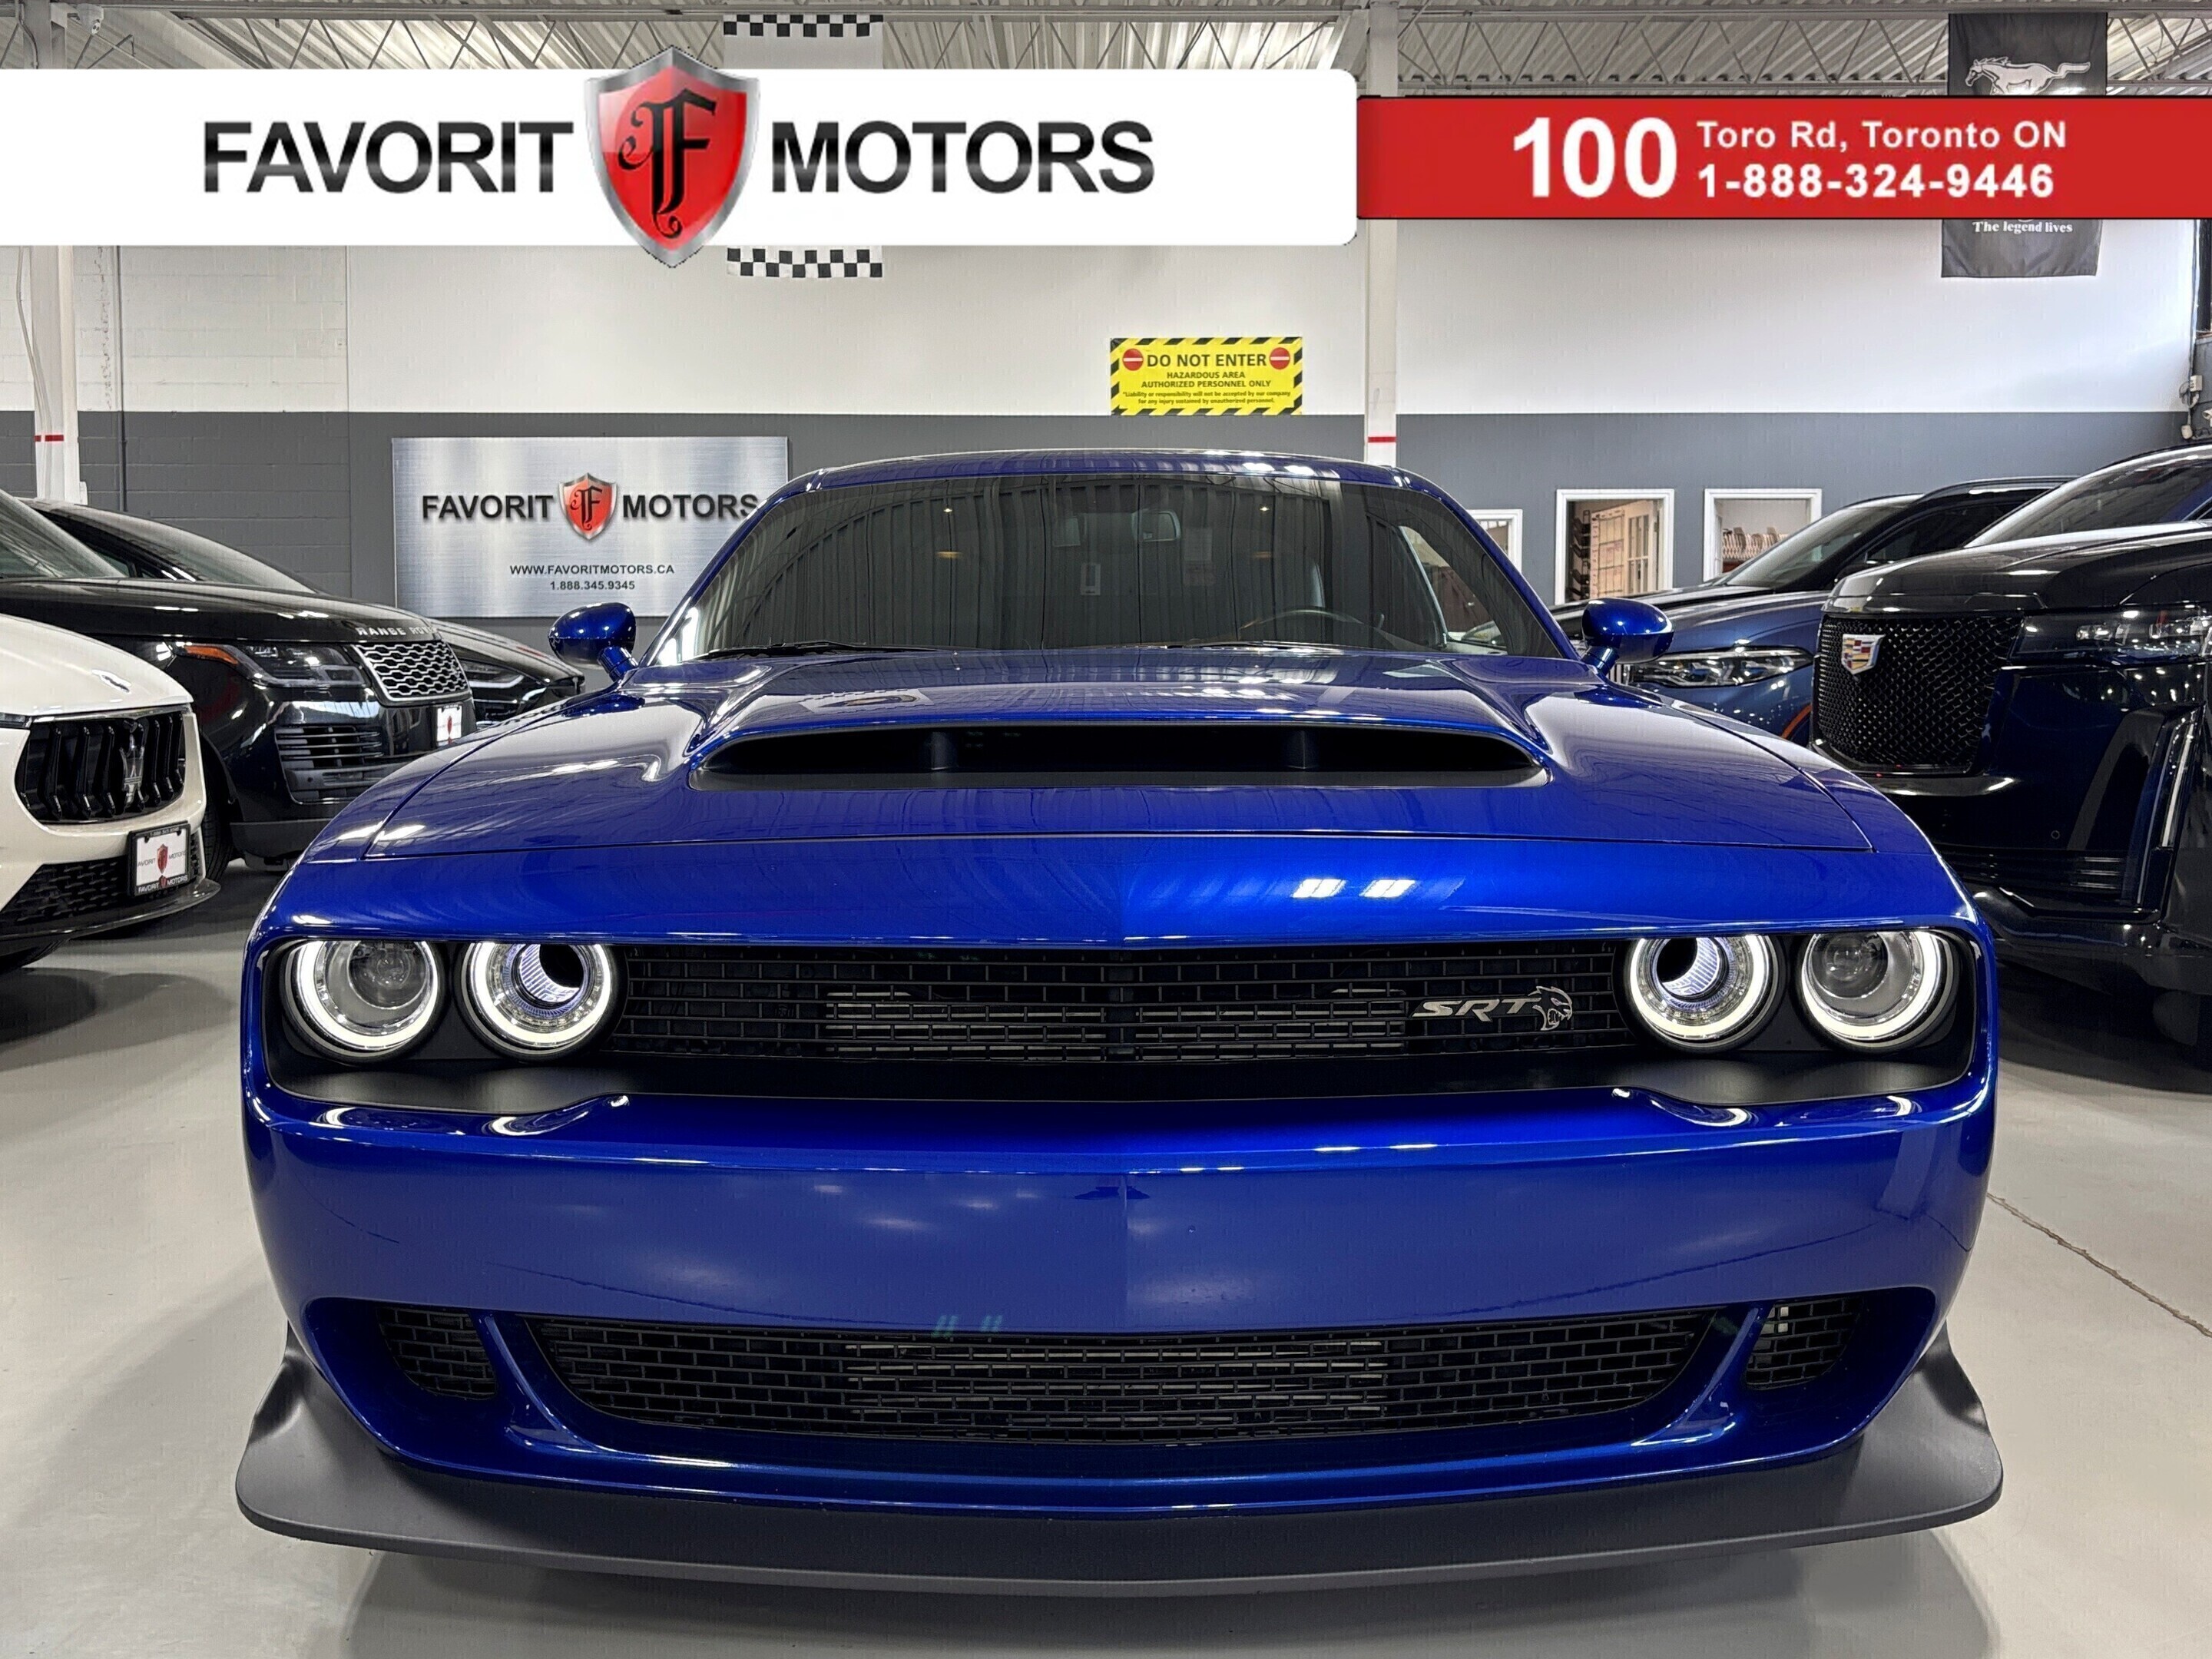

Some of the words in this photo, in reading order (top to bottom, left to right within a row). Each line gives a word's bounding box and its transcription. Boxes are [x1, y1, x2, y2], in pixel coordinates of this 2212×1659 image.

[1972, 220, 2000, 233] The
[2002, 220, 2043, 234] legend
[2045, 221, 2074, 233] lives
[1147, 354, 1171, 367] DO
[1177, 353, 1210, 367] NOT
[1216, 353, 1267, 367] ENTER
[422, 495, 554, 519] FAVORIT
[623, 494, 758, 520] MOTORS
[510, 565, 674, 575] WWW.FAVORITMOTORS.CA
[550, 581, 635, 591] 1.888.345.9345
[355, 627, 406, 636] RANGE
[409, 627, 435, 635] ROV
[137, 857, 157, 867] AVORIT
[138, 882, 160, 893] FAVORIT
[167, 874, 188, 886] MOTORS
[1412, 997, 1541, 1022] SRT
